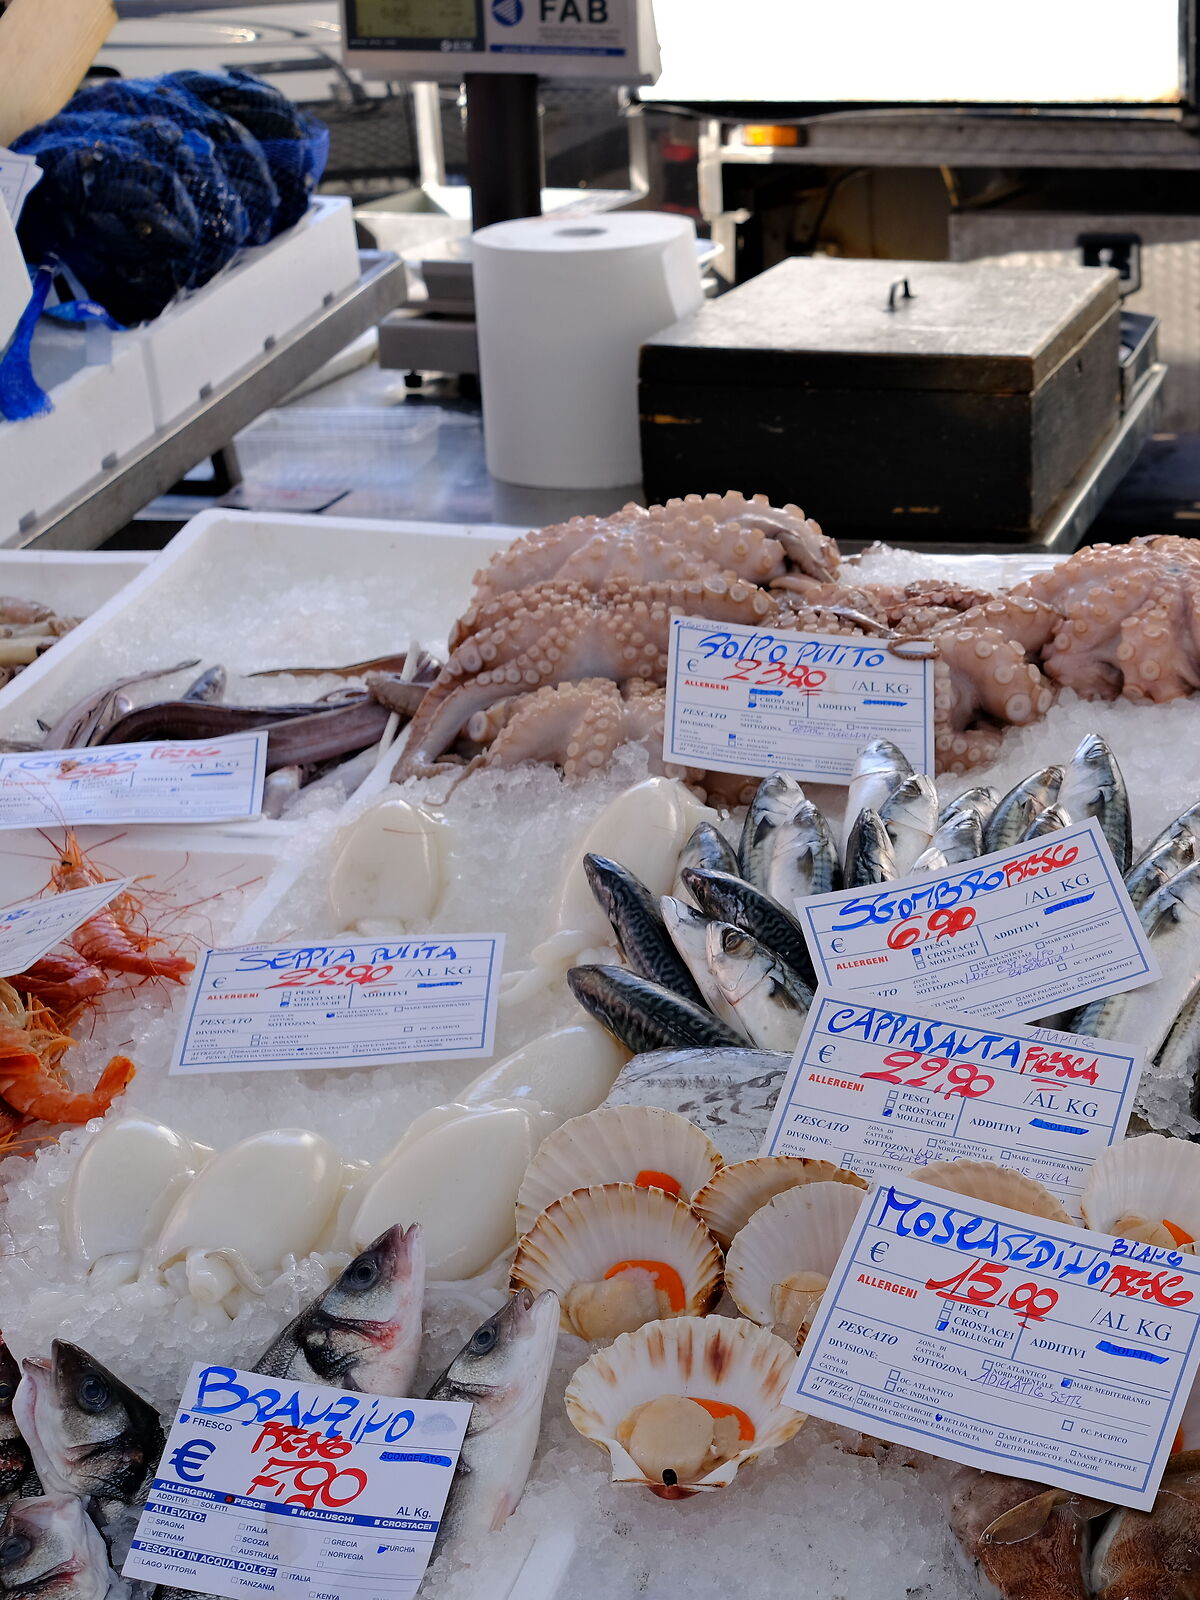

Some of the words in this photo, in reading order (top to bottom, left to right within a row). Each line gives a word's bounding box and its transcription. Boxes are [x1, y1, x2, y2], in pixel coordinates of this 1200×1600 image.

[539, 0, 608, 24] FAB
[685, 680, 729, 691] ALLERGENI
[817, 703, 857, 712] ADDITIVI
[682, 708, 727, 720] PESCATO
[1060, 873, 1090, 892] KG
[927, 941, 979, 959] CROSTACEI
[993, 921, 1040, 940] ADDITIVI
[836, 955, 889, 970] ALLERGENI
[925, 940, 950, 951] PESCI
[929, 949, 977, 966] MOLLUSCHI
[915, 979, 965, 996] SOTTOZONA
[200, 1017, 253, 1026] PESCATO
[809, 1073, 865, 1092] ALLERGENI
[902, 1092, 930, 1104] PESCI
[1066, 1098, 1099, 1117] KG
[793, 1114, 850, 1133] PESCATO
[895, 1113, 947, 1128] MOLLUSCHI
[898, 1104, 955, 1120] CROSTACEI
[970, 1118, 1022, 1134] ADDITIVI
[862, 1138, 914, 1154] SOTTOZONA
[865, 1160, 903, 1172] ATLANTICO
[1010, 1153, 1030, 1161] MARE
[1031, 1157, 1084, 1172] MEDITERRANEO
[857, 1273, 918, 1300] ALLERGENI
[958, 1304, 990, 1319] PESCI
[837, 1320, 899, 1346] PESCATO
[918, 1339, 936, 1349] ZONA
[950, 1327, 1005, 1349] MOLLUSCHI
[953, 1316, 1015, 1340] CROSTACEI
[1030, 1338, 1086, 1359] ADDITIVI
[1136, 1318, 1172, 1342] KG
[819, 1362, 849, 1376] CATTURA
[828, 1337, 879, 1360] DIVISIONE:
[915, 1346, 946, 1360] CATTURA
[1008, 1365, 1047, 1380] ATLANTICO
[823, 1353, 840, 1364] ZONA
[912, 1354, 967, 1377] SOTTOZONA
[1073, 1381, 1094, 1392] MARE
[1095, 1387, 1151, 1406] MEDITERRANEO
[914, 1381, 954, 1398] ATLANTICO
[815, 1376, 854, 1392] ATTREZZO
[866, 1392, 893, 1406] DRAGHE
[899, 1403, 934, 1418] SCIABICHE
[970, 1424, 994, 1436] TRAINO
[909, 1390, 940, 1404] INDIANO
[1093, 1430, 1128, 1444] PACIFICO
[192, 1418, 232, 1433] FRESCO
[888, 1408, 930, 1426] CIRCUIZIONE
[945, 1426, 981, 1442] RACCOLTA
[1023, 1438, 1060, 1452] PALANGARI
[1077, 1452, 1098, 1462] NASSE
[1104, 1459, 1138, 1472] TRAPPOLE
[1028, 1449, 1058, 1461] IMBOCCO
[1063, 1457, 1100, 1472] ANALOGHE
[152, 1504, 206, 1522] ALLEVATO:
[156, 1492, 190, 1504] ADDITIVI:
[200, 1502, 228, 1512] SOLFITI
[159, 1482, 216, 1500] ALLERGENI:
[234, 1498, 267, 1510] PESCE
[299, 1509, 355, 1523] MOLLUSCHI
[381, 1520, 432, 1530] CROSTACEI
[396, 1507, 411, 1517] AL
[414, 1507, 431, 1520] Kg.
[151, 1530, 185, 1542] VIETNAM
[241, 1536, 270, 1547] SCOZIA
[327, 1550, 364, 1561] NORVEGIA
[155, 1518, 185, 1530] SPAGNA
[245, 1525, 268, 1535] ITALIA
[331, 1538, 358, 1548] GRECIA
[386, 1544, 416, 1553] TURCHIA
[138, 1541, 187, 1560] PESCATO
[187, 1552, 199, 1561] IN
[200, 1555, 236, 1570] ACQUA
[238, 1562, 277, 1577] DOLCE:
[288, 1573, 311, 1583] ITALIA
[238, 1548, 280, 1561] AUSTRALIA
[141, 1558, 163, 1569] LAGO
[164, 1563, 197, 1576] VITTORIA
[239, 1578, 275, 1592] TANZANIA
[316, 1592, 340, 1600] KENYA
